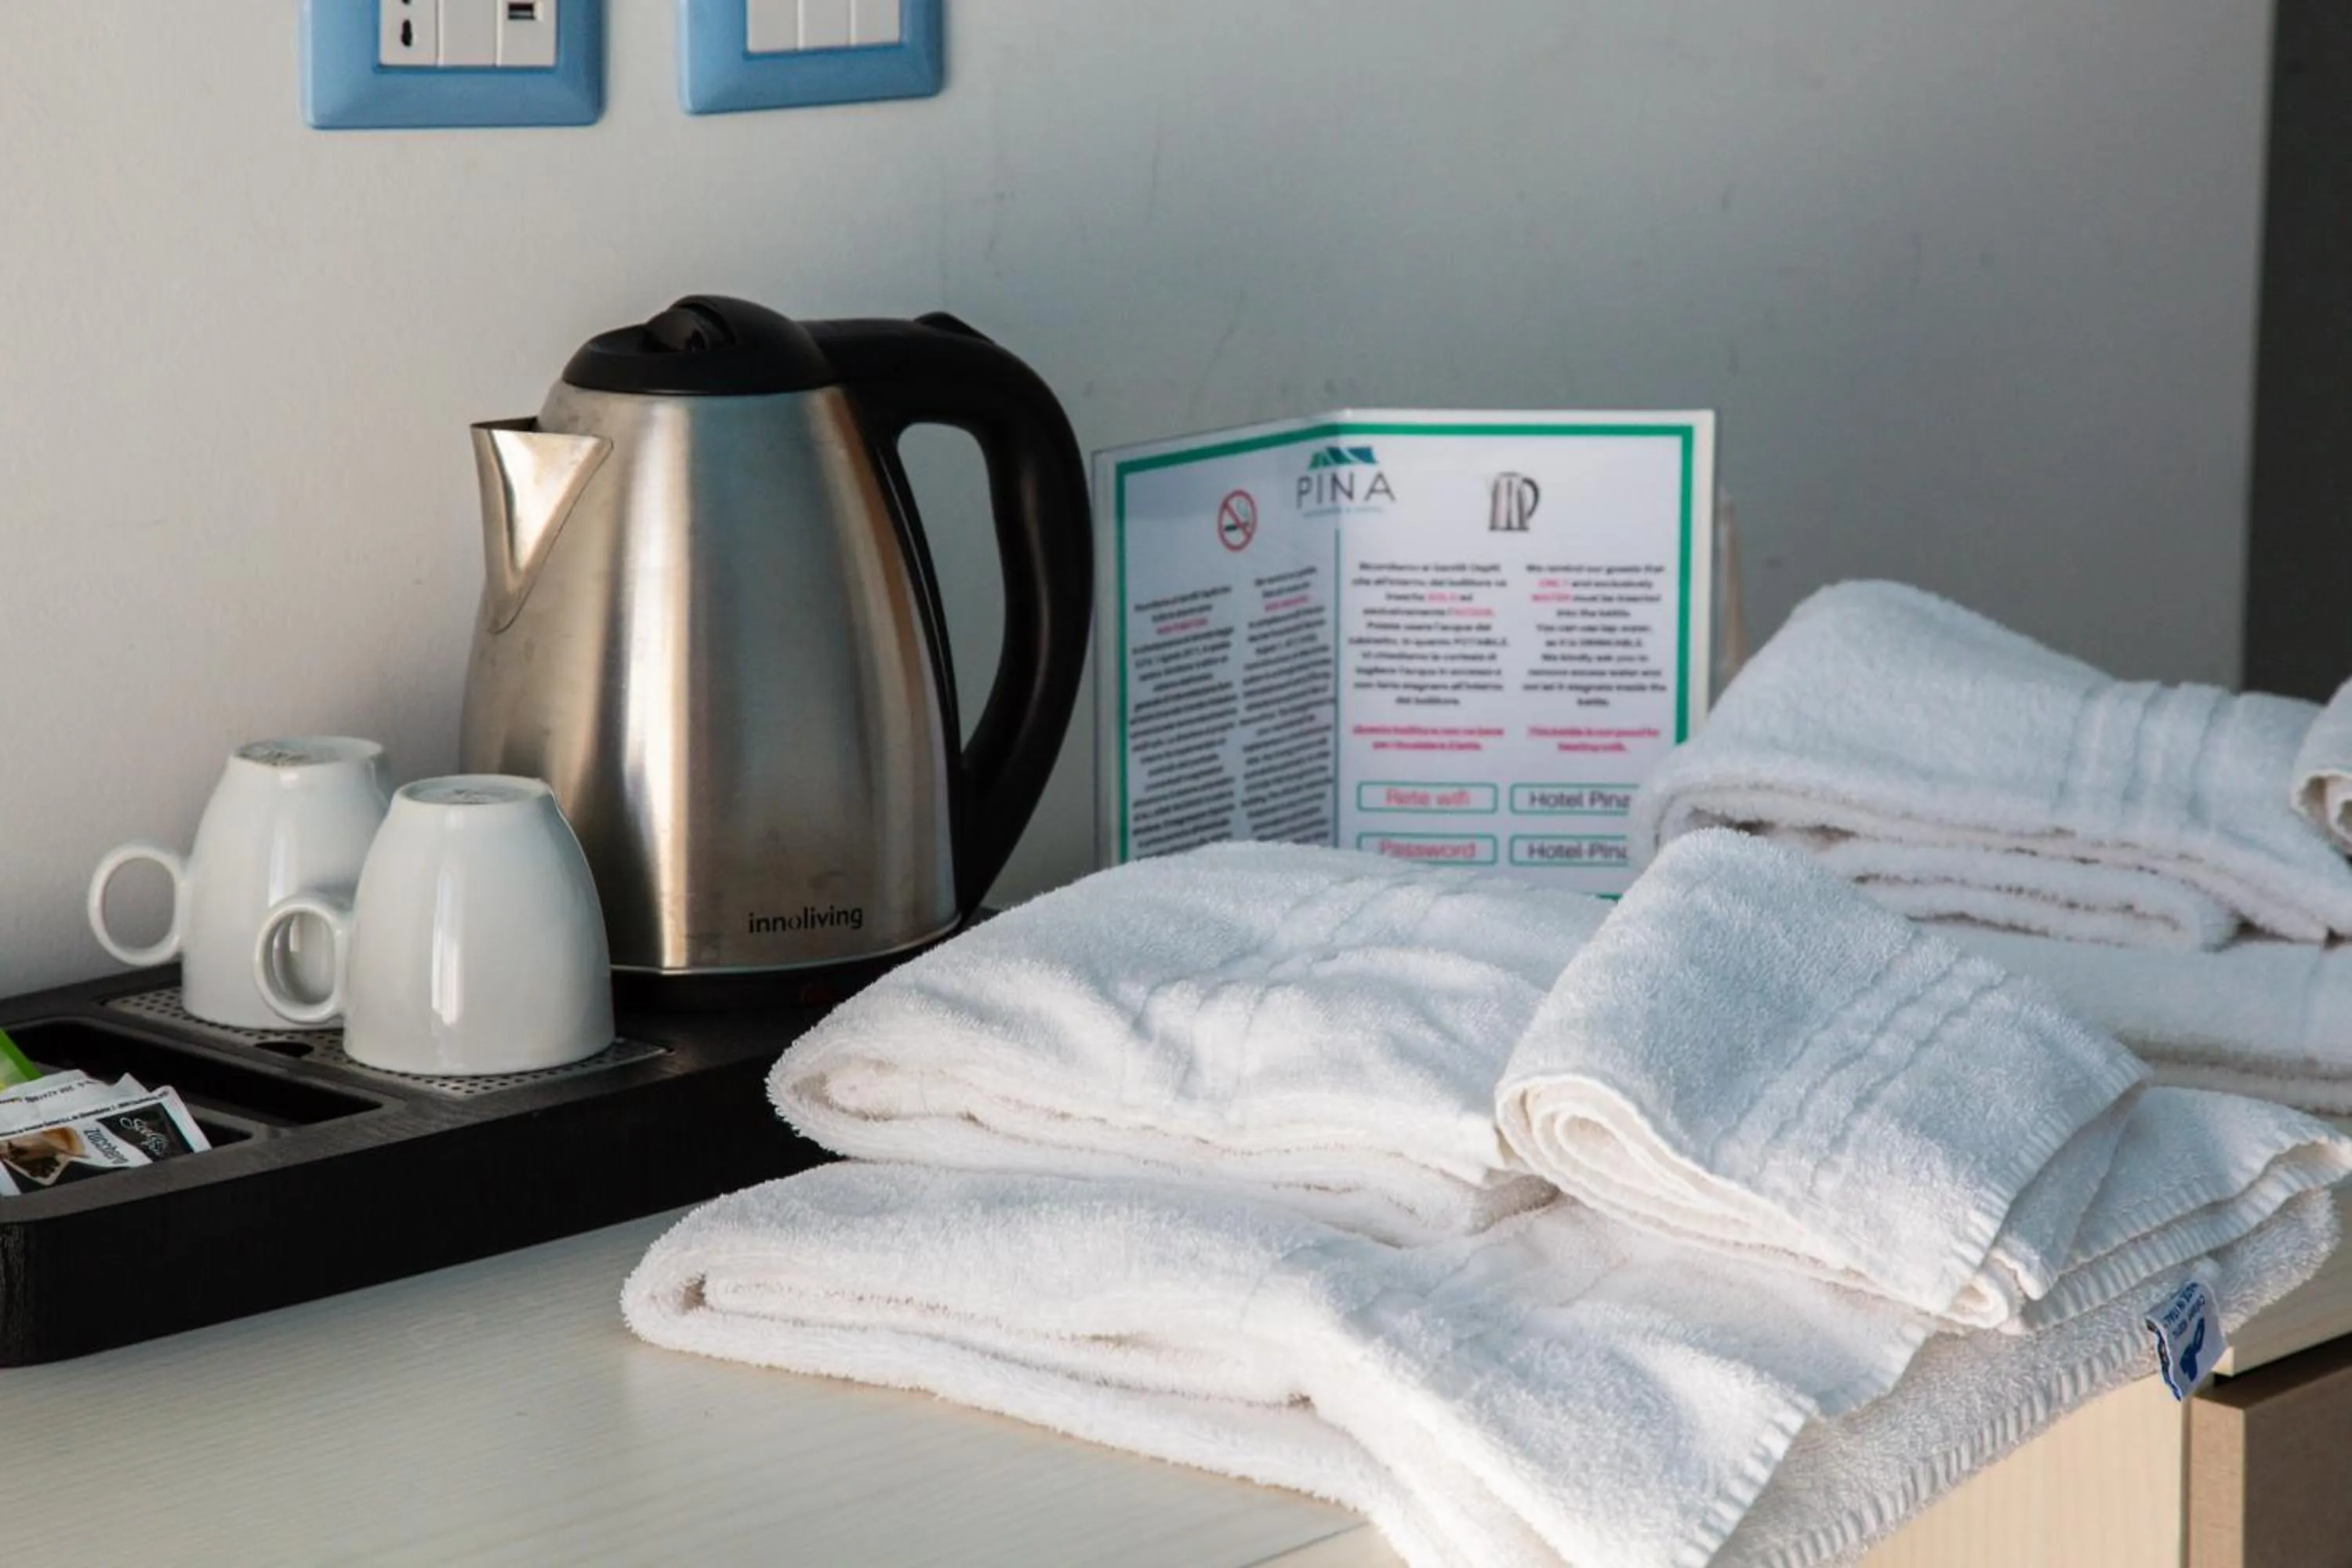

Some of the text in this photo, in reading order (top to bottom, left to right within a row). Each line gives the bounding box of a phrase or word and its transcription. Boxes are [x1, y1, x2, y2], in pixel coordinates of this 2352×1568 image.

[1296, 470, 1398, 510] PINA
[1529, 791, 1584, 808] Hotel
[1528, 843, 1582, 859] Hotel
[748, 905, 863, 934] innoliving
